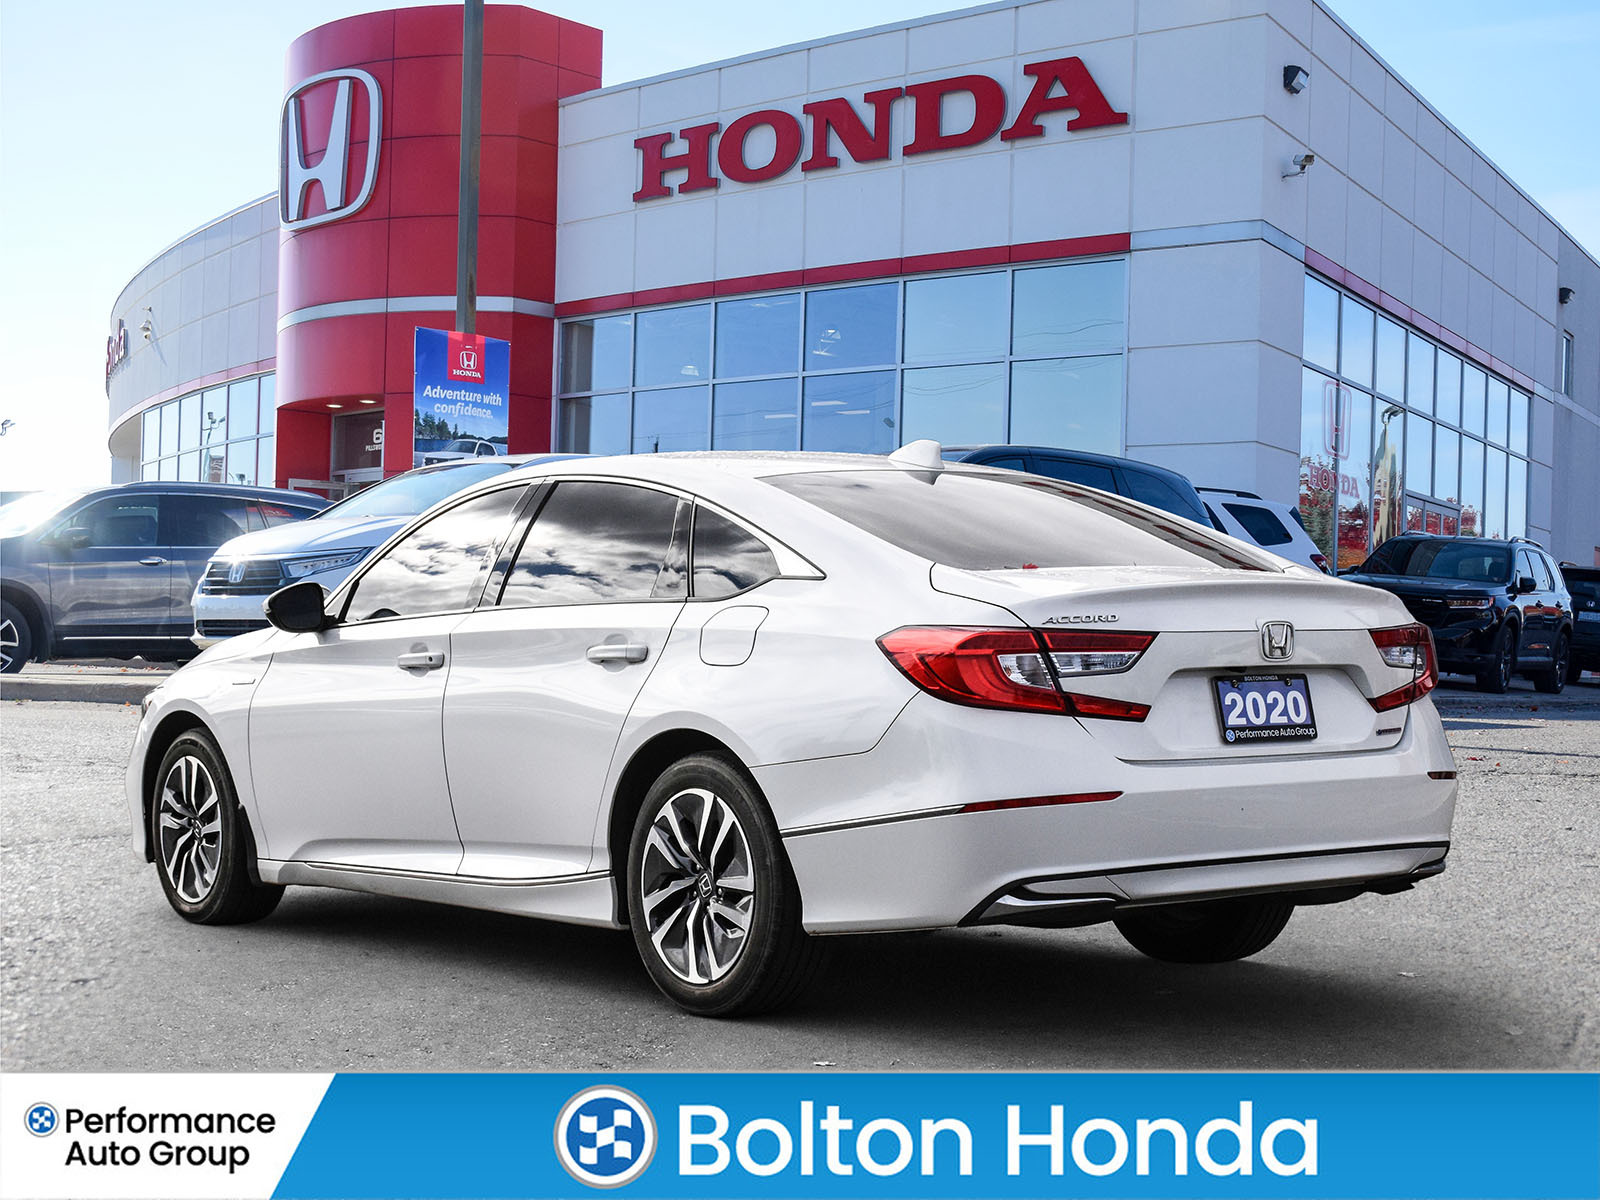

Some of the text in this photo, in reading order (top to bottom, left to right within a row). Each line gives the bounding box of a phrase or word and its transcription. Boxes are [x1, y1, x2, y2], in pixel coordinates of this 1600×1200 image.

[633, 56, 1129, 202] HONDA
[453, 369, 482, 378] HONDA
[423, 385, 502, 406] Adventure with
[434, 403, 493, 418] confidence.
[373, 428, 383, 443] 6
[1307, 463, 1360, 499] HONDA
[1042, 614, 1120, 625] ACCORD
[1225, 690, 1307, 725] 2020
[1235, 727, 1316, 739] Performance Auto Group
